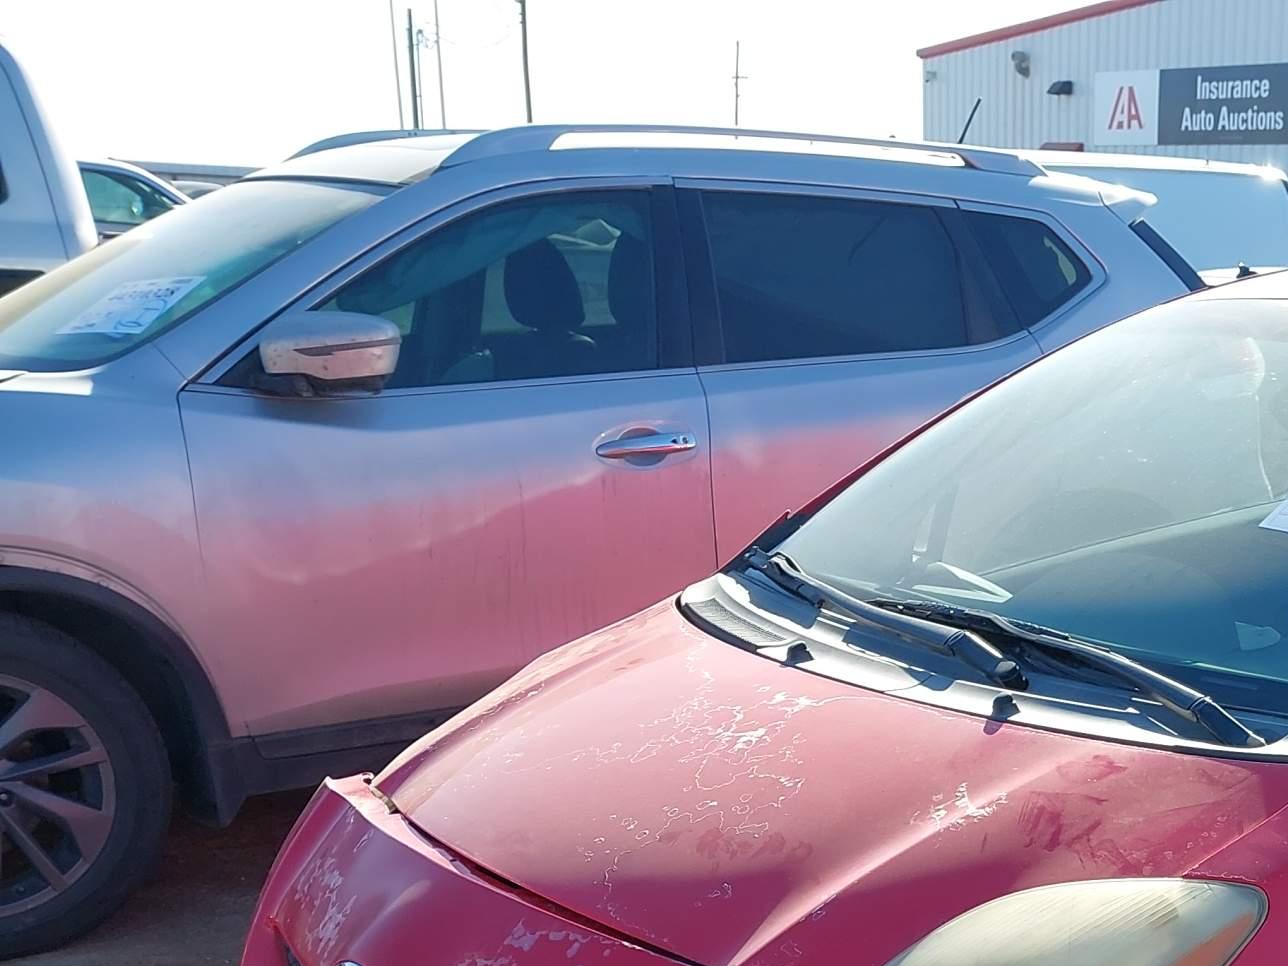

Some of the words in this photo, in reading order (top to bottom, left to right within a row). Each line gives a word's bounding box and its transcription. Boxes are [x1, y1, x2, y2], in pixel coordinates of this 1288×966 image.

[1196, 75, 1269, 99] Insurance
[1181, 107, 1214, 131] Auto
[1218, 105, 1284, 130] Auctions
